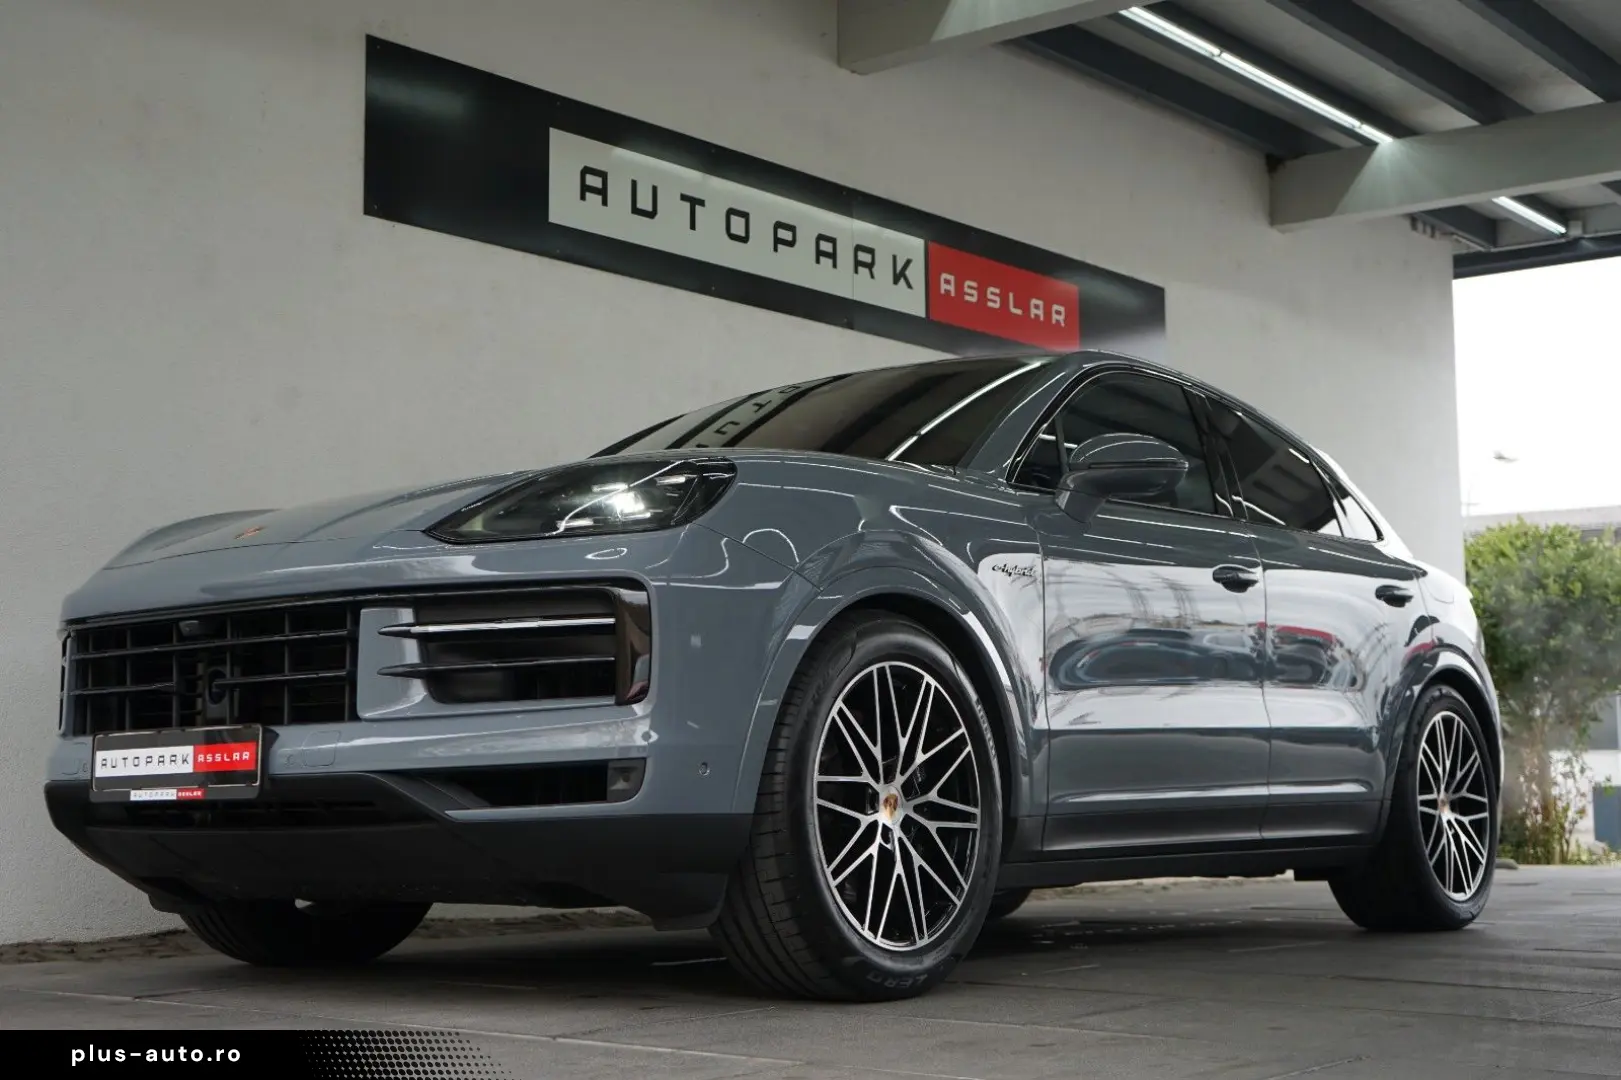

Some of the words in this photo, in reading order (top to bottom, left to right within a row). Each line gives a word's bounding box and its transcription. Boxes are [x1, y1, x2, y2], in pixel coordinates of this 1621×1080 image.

[579, 165, 914, 290] AUTOPARK
[940, 272, 1066, 325] ASSLAR
[101, 753, 190, 768] AUTOPARK
[197, 751, 250, 763] ASSLAR
